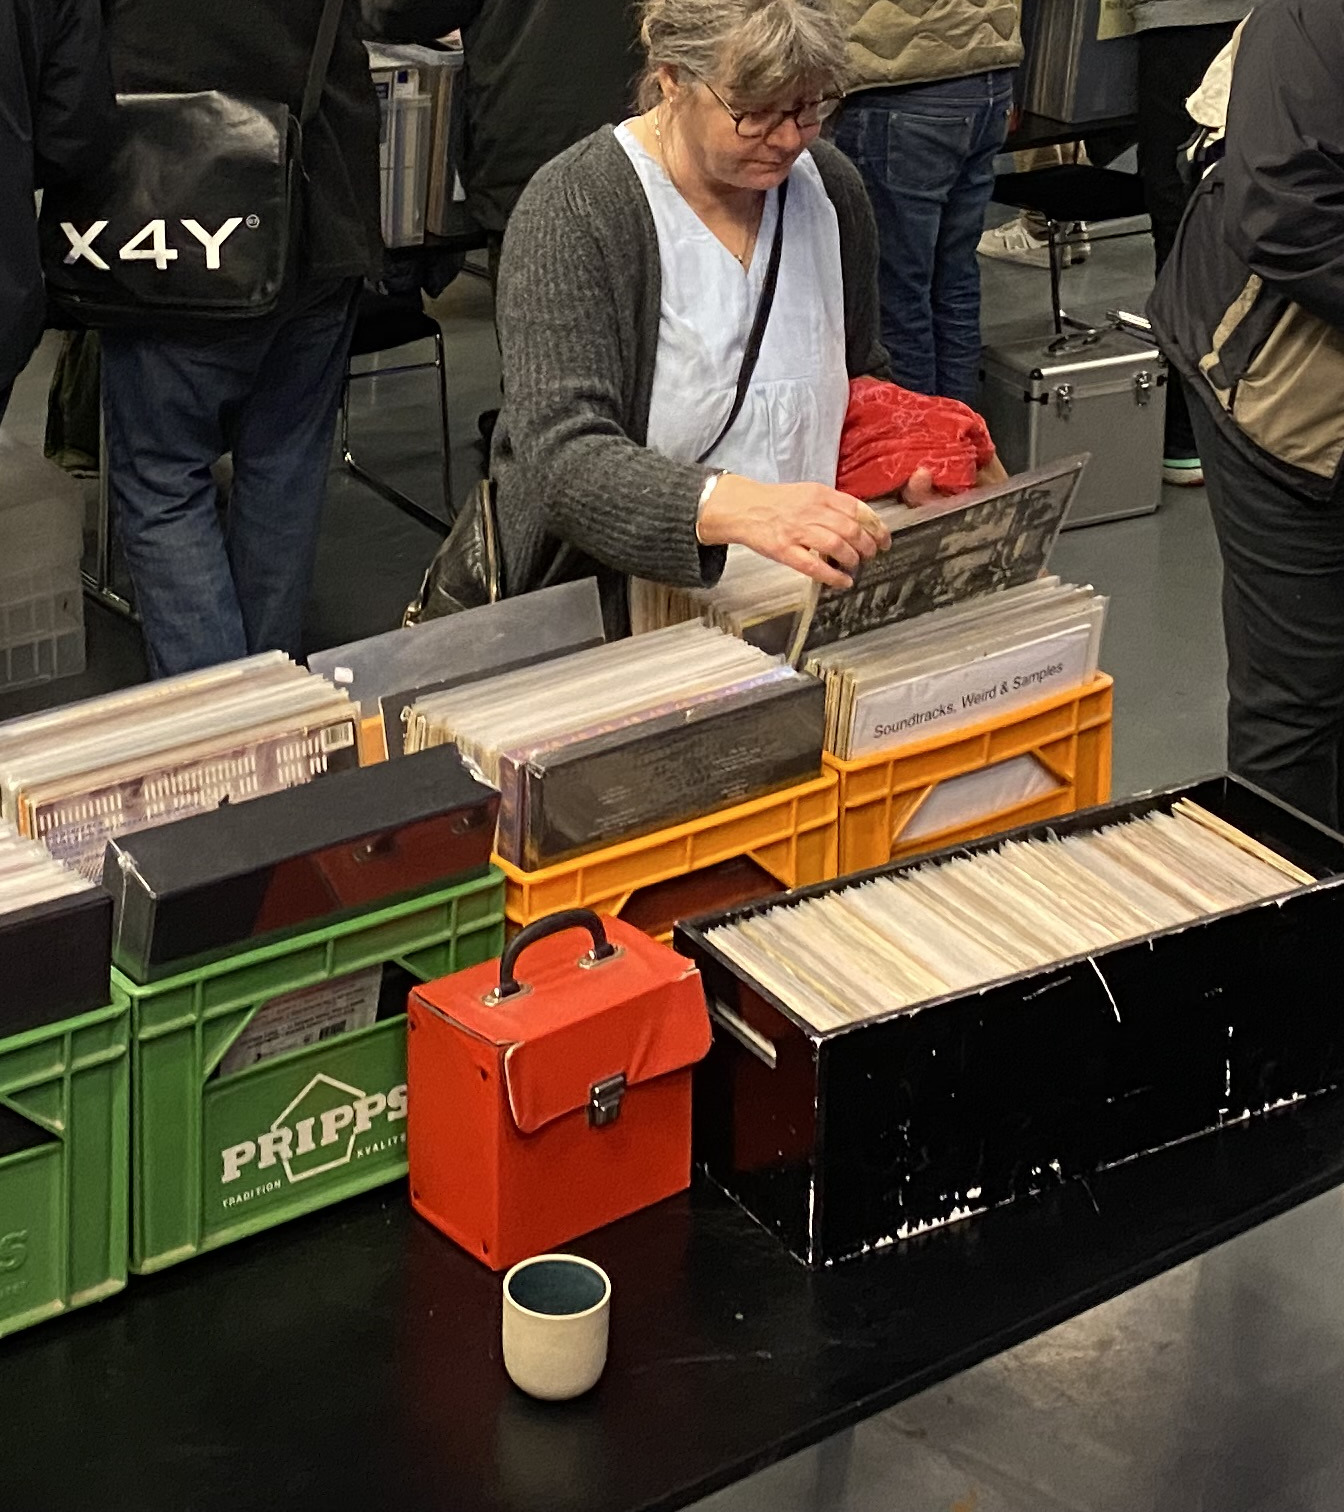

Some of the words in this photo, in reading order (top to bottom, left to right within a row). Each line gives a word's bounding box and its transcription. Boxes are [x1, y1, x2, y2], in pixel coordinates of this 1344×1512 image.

[60, 217, 244, 271] X4Y
[961, 687, 996, 709] Weird
[999, 680, 1010, 696] &
[1012, 662, 1064, 690] Samples
[221, 1084, 408, 1183] PRIPPS
[222, 1178, 282, 1208] TRADITION
